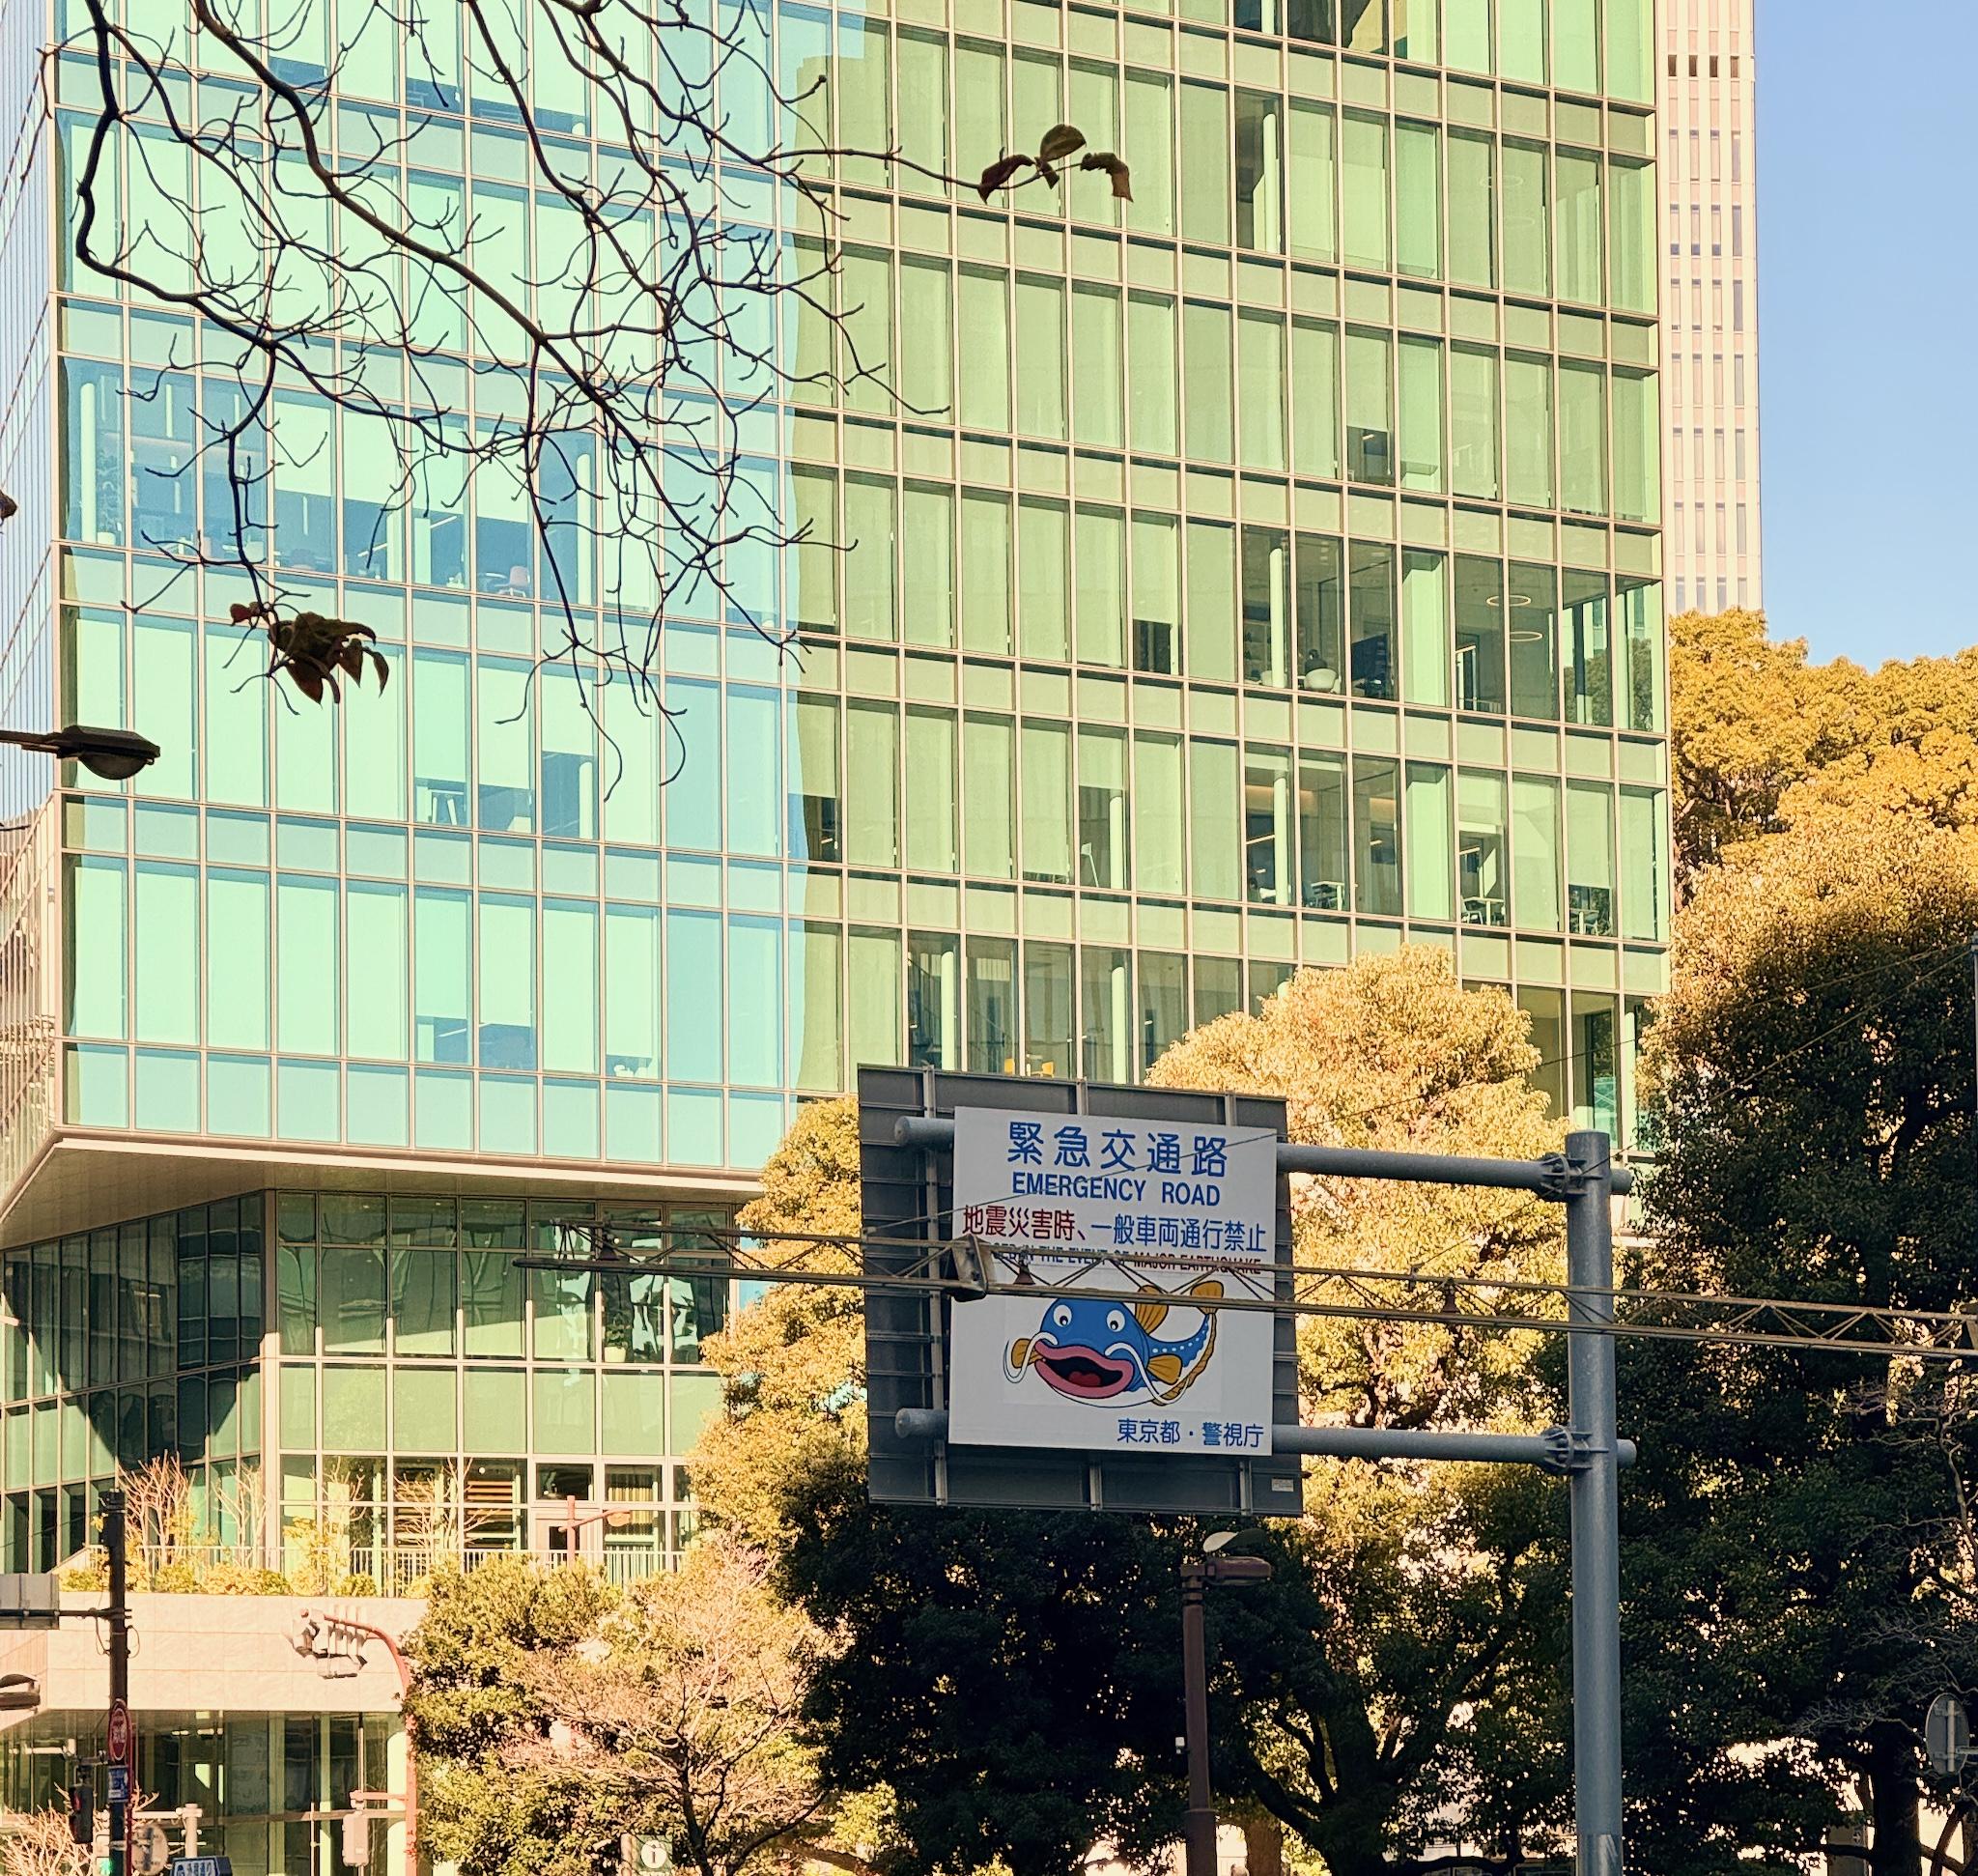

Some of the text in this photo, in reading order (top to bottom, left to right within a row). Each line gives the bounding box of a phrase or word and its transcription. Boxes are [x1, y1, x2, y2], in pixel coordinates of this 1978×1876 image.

[1007, 1121, 1228, 1178] 緊急交通路
[1012, 1171, 1221, 1207] EMERGENCY ROAD
[962, 1204, 1267, 1253] 地震災害時、一般車両通行禁止
[1116, 1417, 1265, 1448] 東京都・警視庁
